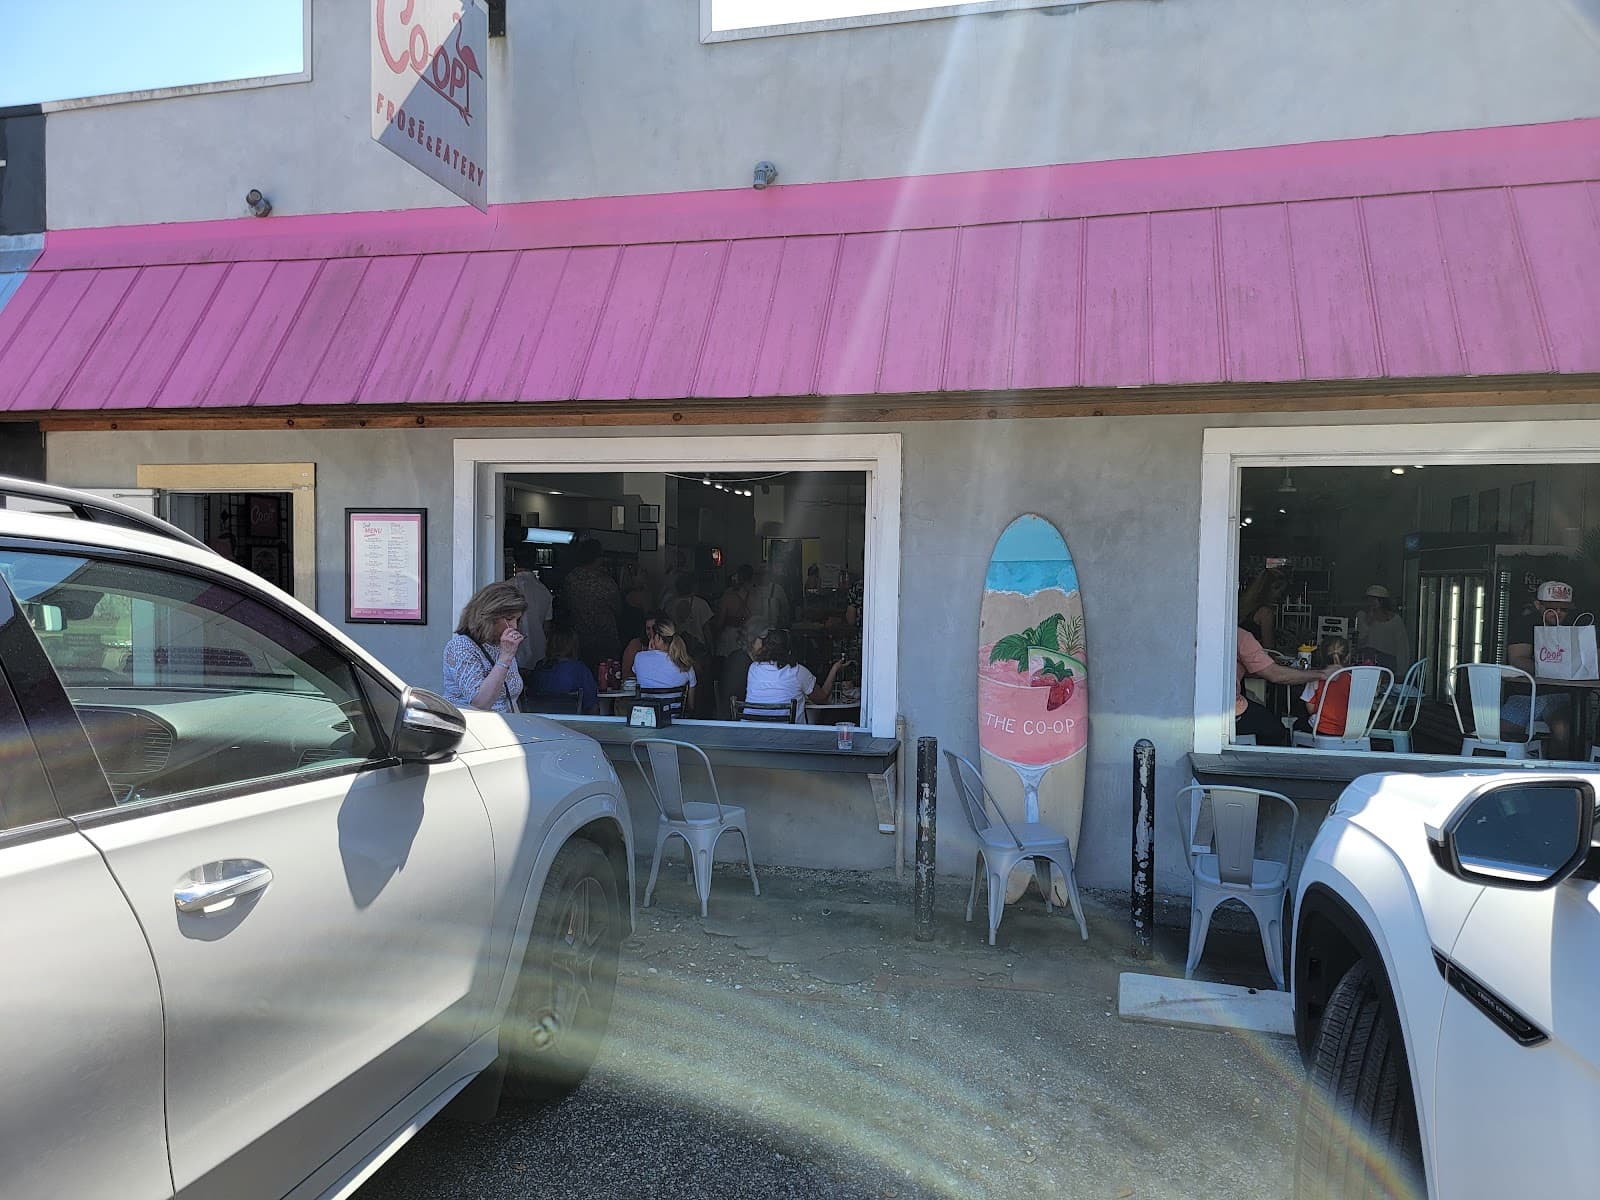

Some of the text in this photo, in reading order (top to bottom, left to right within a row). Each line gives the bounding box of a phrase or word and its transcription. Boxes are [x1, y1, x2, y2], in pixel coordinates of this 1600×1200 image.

[435, 137, 485, 187] EATERY
[985, 712, 1075, 735] THE CO-OP
